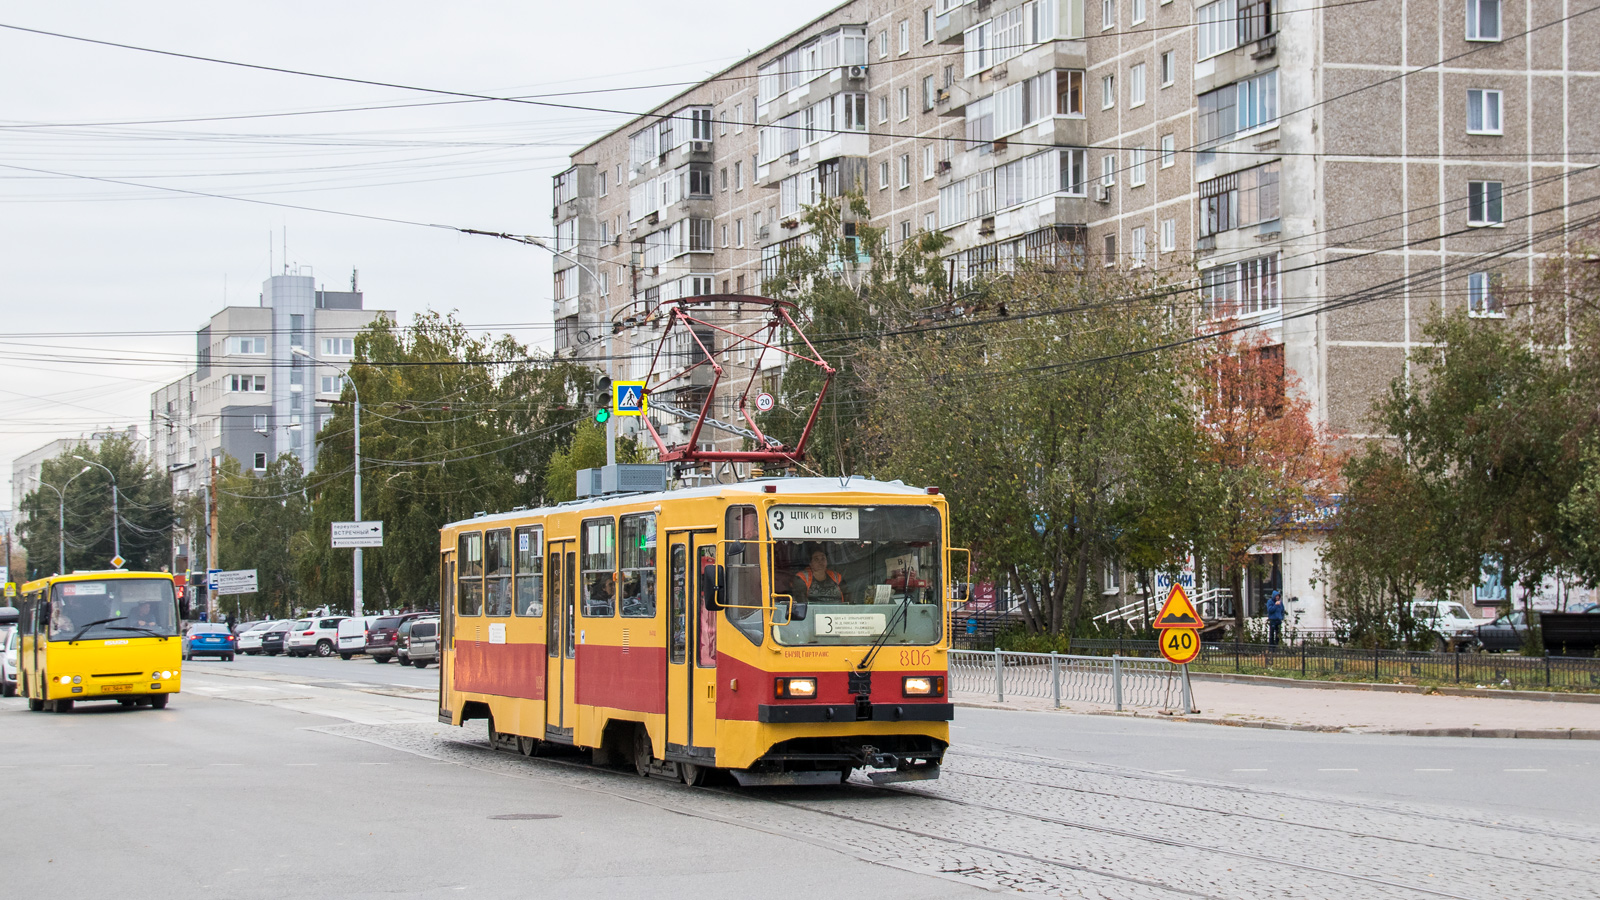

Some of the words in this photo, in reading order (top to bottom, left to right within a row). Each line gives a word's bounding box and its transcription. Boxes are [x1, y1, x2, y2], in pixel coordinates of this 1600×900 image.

[760, 398, 770, 406] 20
[773, 510, 784, 531] 3
[831, 511, 853, 520] ВИЗ
[824, 616, 833, 634] 3
[1168, 633, 1192, 650] 40
[900, 649, 931, 666] 806
